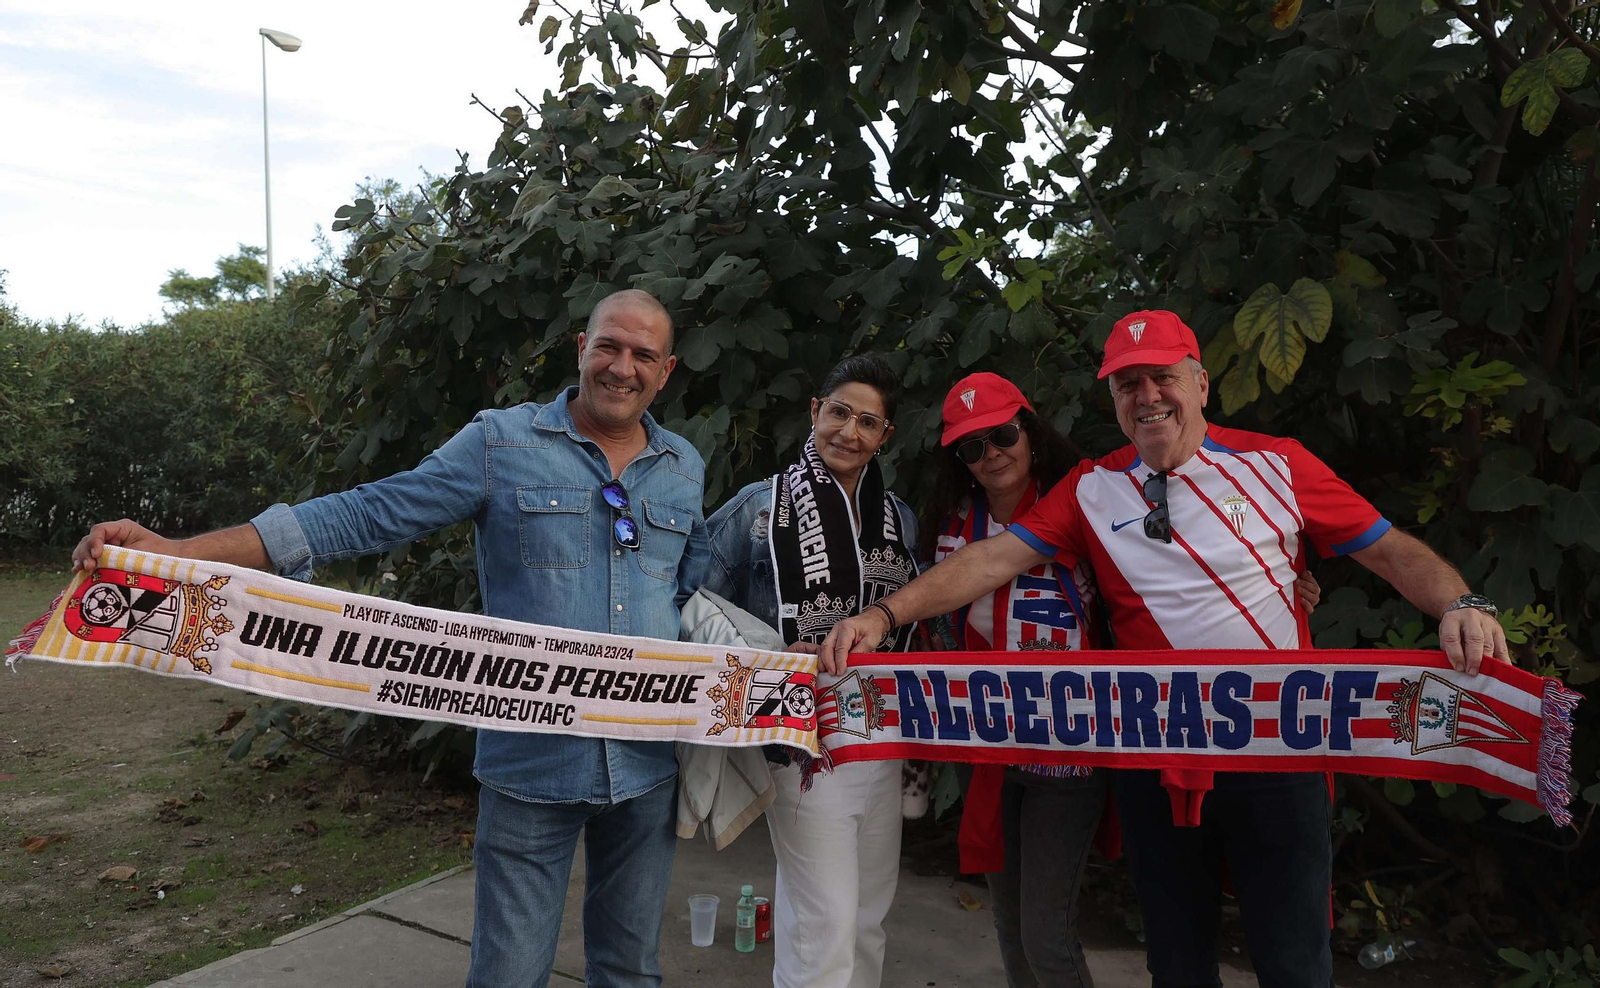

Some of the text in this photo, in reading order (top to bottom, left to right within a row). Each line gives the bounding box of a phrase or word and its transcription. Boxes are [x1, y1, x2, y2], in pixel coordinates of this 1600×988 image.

[239, 611, 705, 704] UNA ILUSIÓN NOS PERSIGUE
[343, 604, 371, 622] PLAY
[372, 610, 391, 625] OFF
[391, 612, 438, 633] ASCENSO
[444, 622, 468, 639] LIGA
[470, 627, 536, 650] HYPERMOTION
[544, 637, 603, 658] TEMPORADA
[604, 647, 634, 661] 23/24
[376, 680, 576, 726] #SIEMPREADCEUTAFC
[894, 670, 1379, 750] ALGECIRAS CF
[1444, 705, 1456, 738] ALGECIRAS
